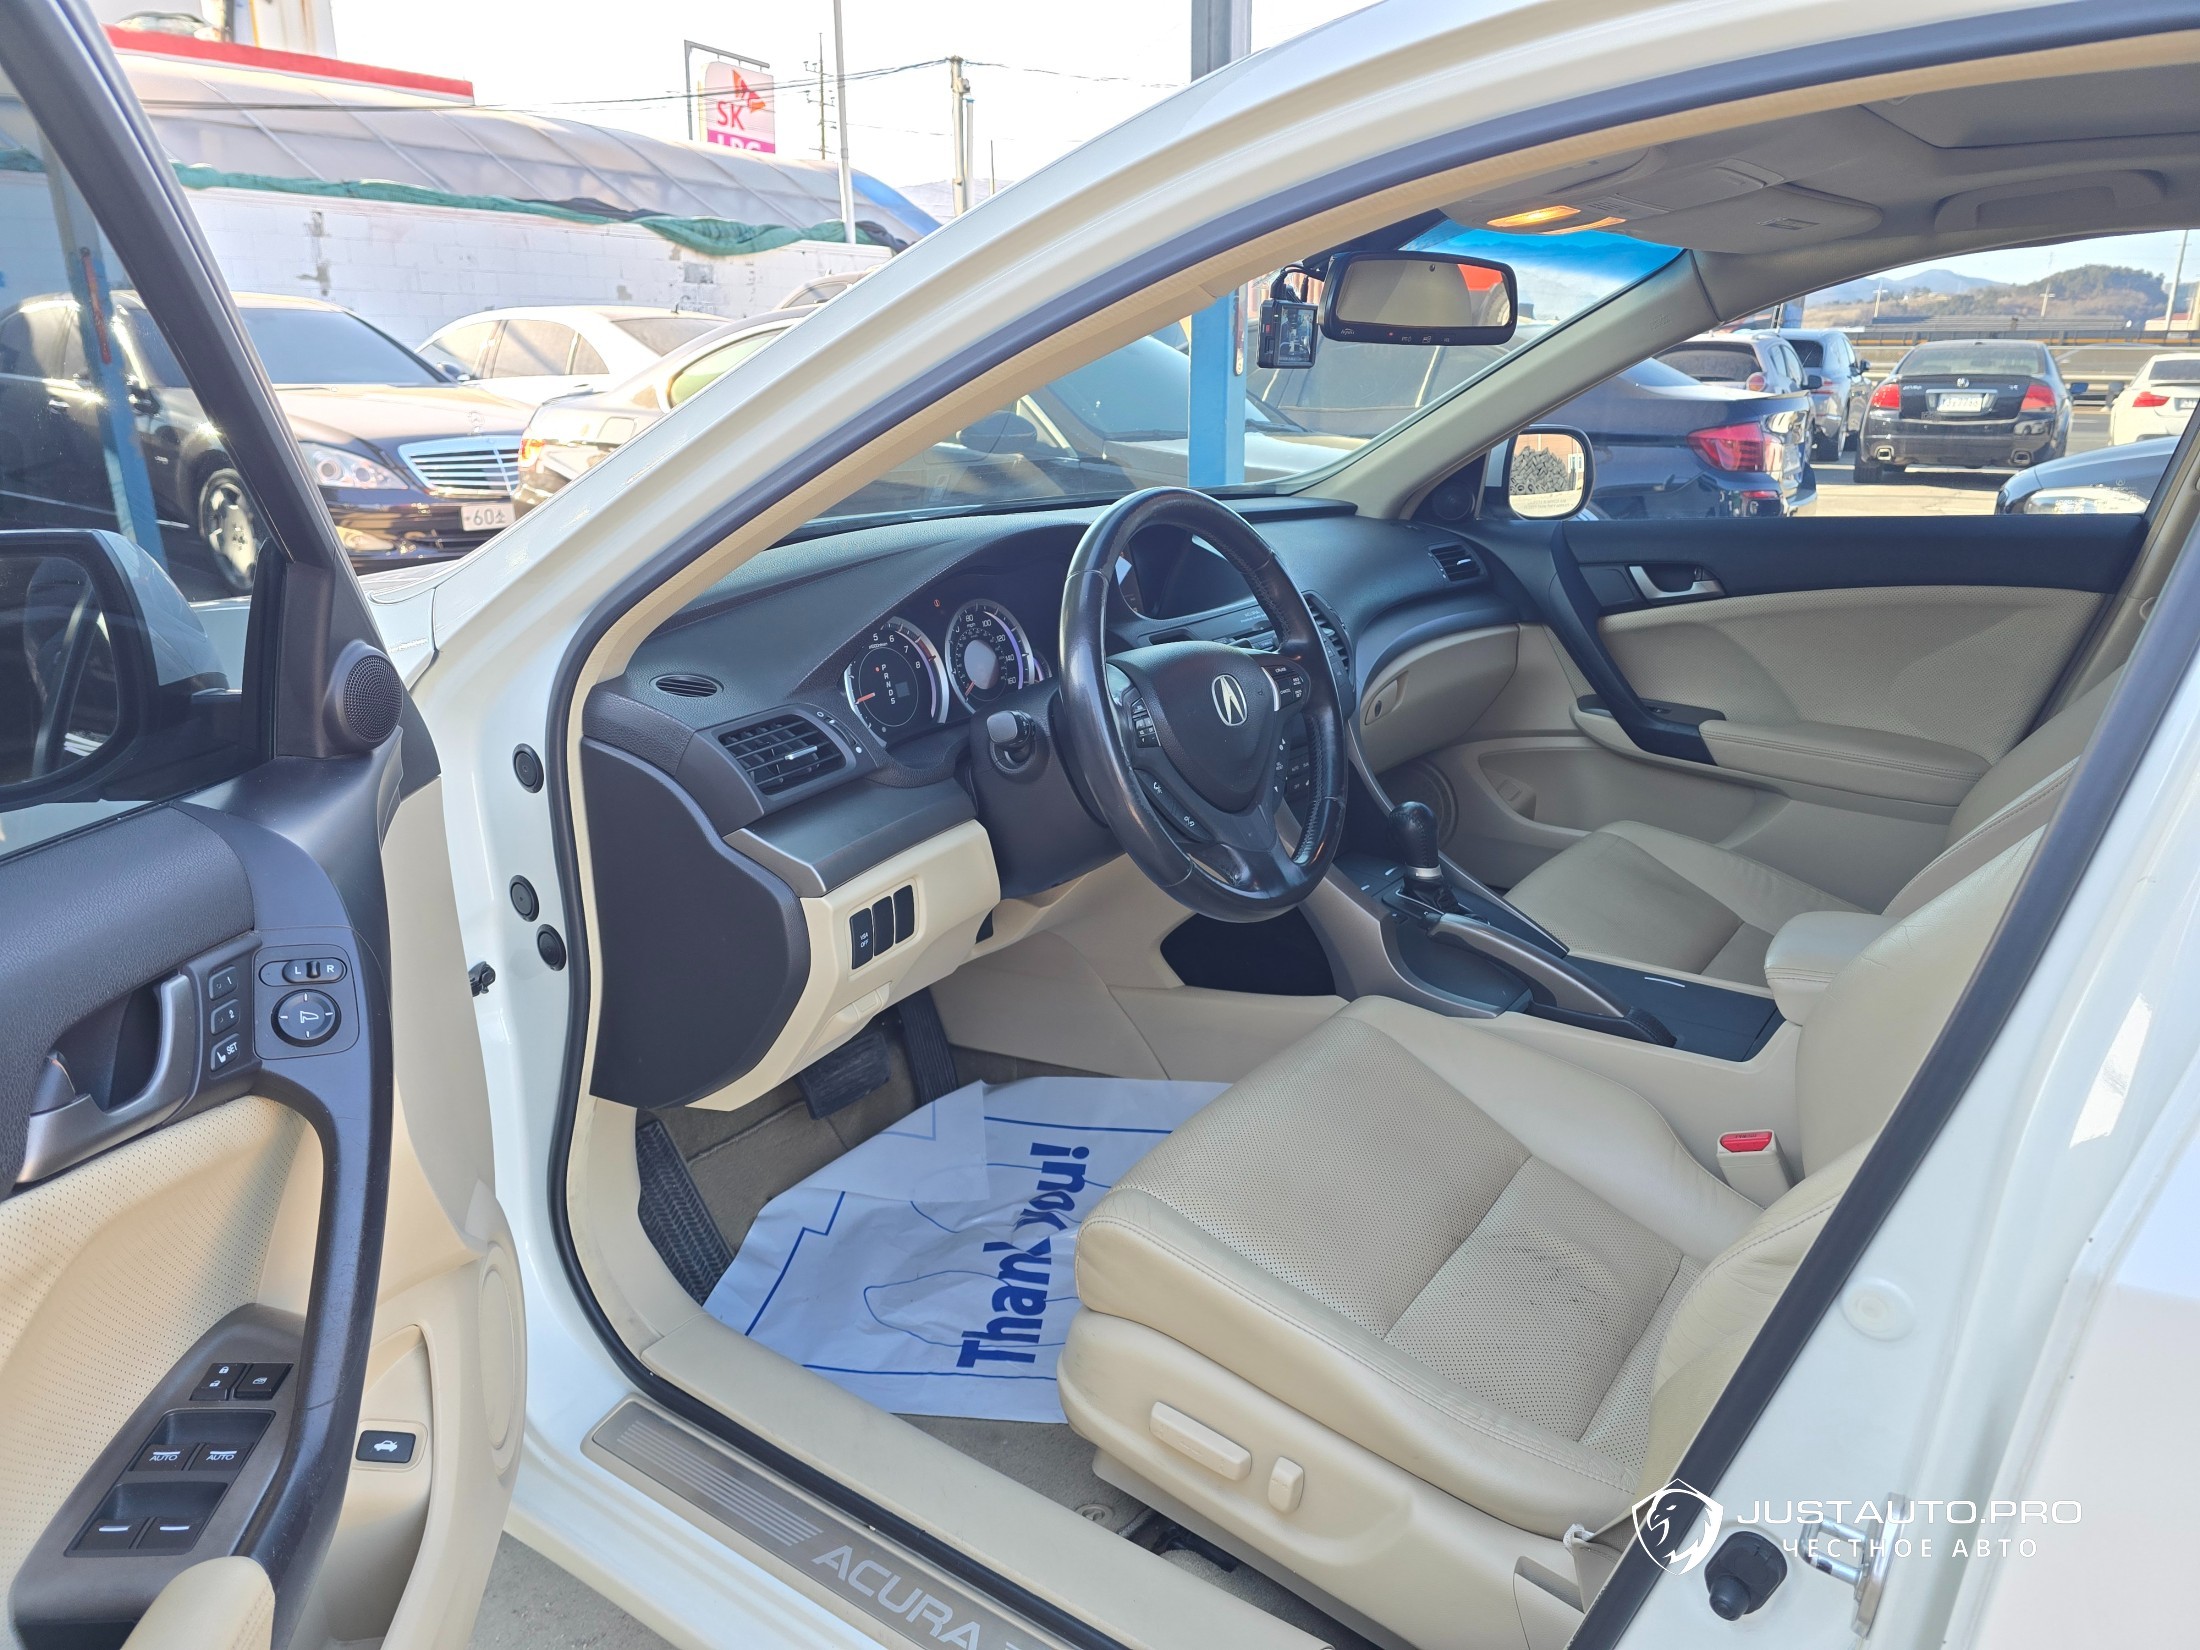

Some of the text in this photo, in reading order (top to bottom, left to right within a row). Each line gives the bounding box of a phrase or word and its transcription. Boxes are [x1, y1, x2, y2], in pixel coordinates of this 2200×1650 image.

[717, 100, 745, 131] SK
[884, 672, 890, 680] R
[886, 680, 892, 688] N
[294, 966, 302, 975] L
[326, 964, 335, 973] R
[228, 1010, 235, 1018] 2
[226, 1042, 238, 1055] SET
[956, 1142, 1090, 1368] Thank you!
[811, 1544, 981, 1650] ACURA
